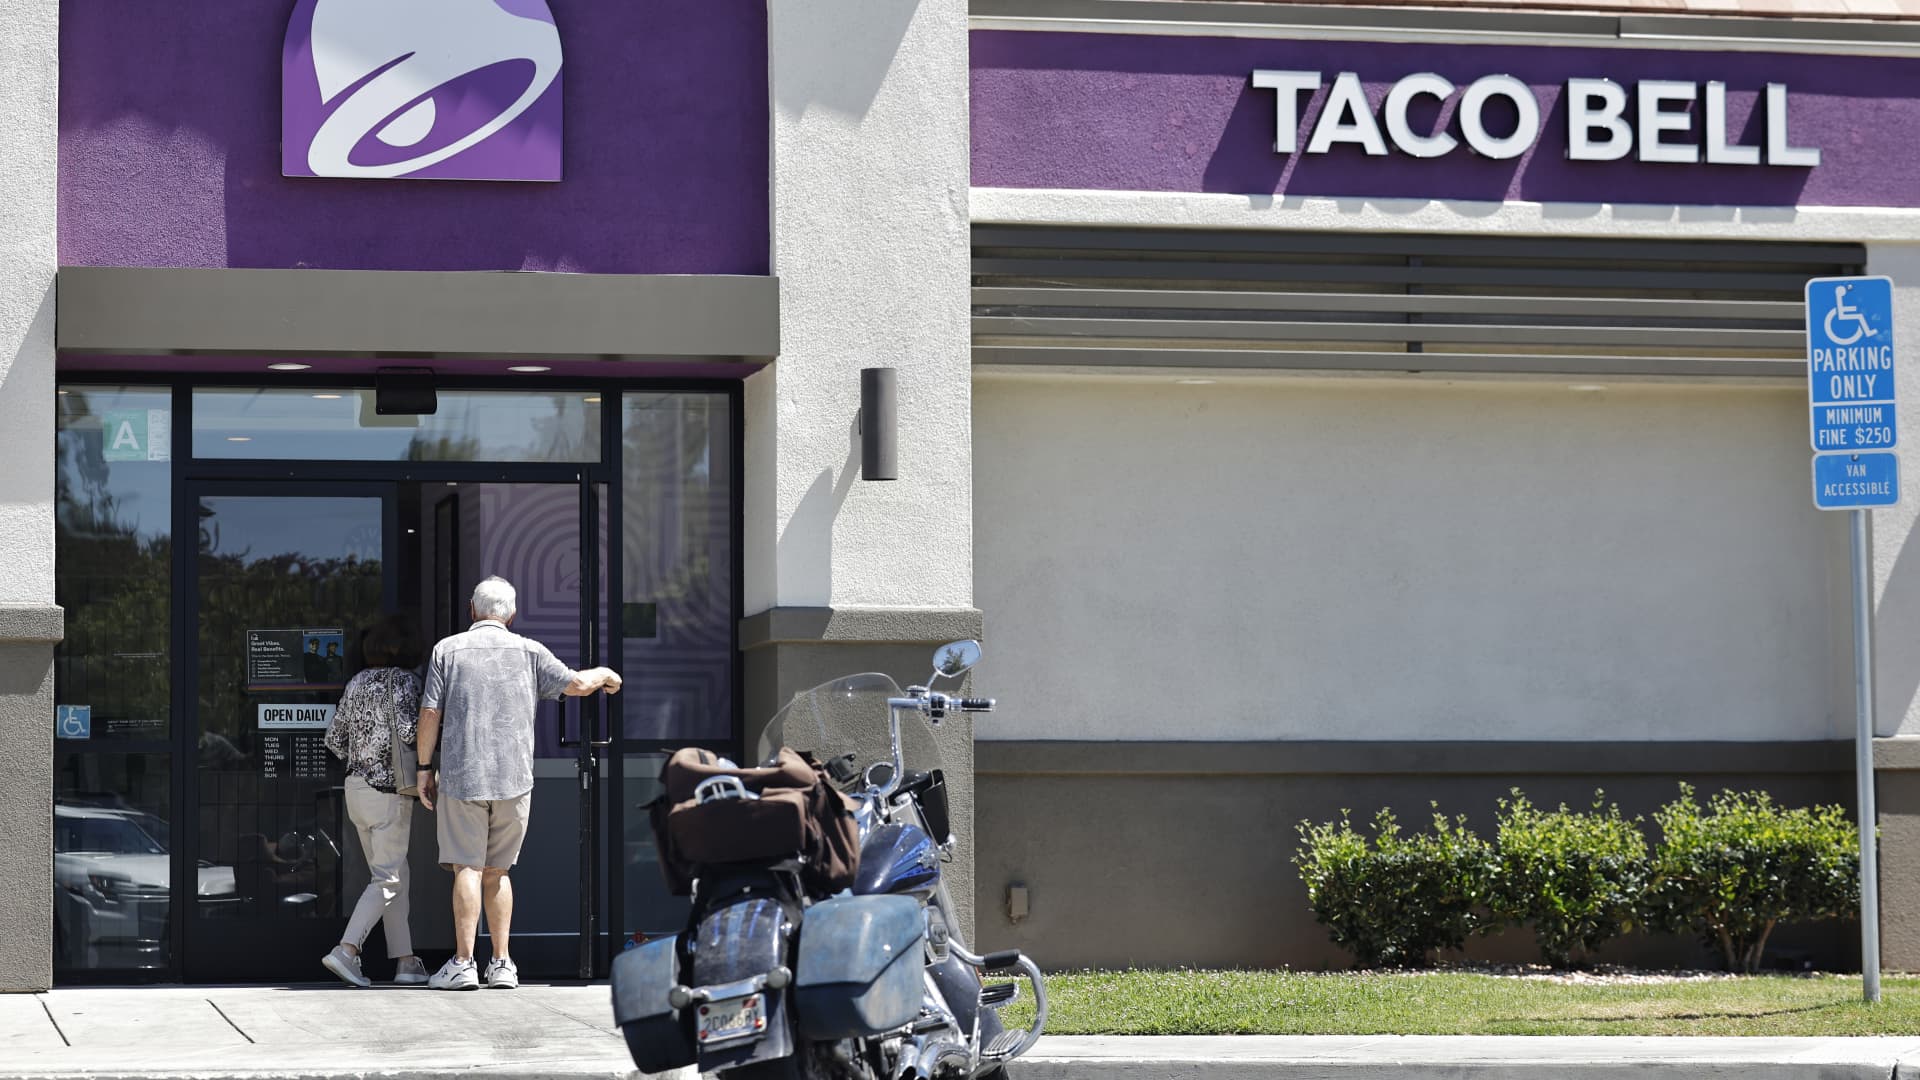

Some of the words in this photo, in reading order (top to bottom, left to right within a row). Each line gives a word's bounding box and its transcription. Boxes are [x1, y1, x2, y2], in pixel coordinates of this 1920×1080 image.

[1251, 69, 1540, 160] TACO
[1566, 76, 1822, 167] BELL
[1813, 345, 1892, 372] PARKING
[1830, 374, 1877, 399] ONLY
[1826, 407, 1882, 425] MINIMUM
[112, 420, 140, 450] A
[1819, 428, 1848, 446] FINE
[1855, 425, 1891, 445] $250
[1846, 464, 1867, 477] VAN
[1824, 481, 1891, 497] ACCESSIBLE
[264, 709, 293, 722] OPEN
[296, 709, 327, 722] DAILY
